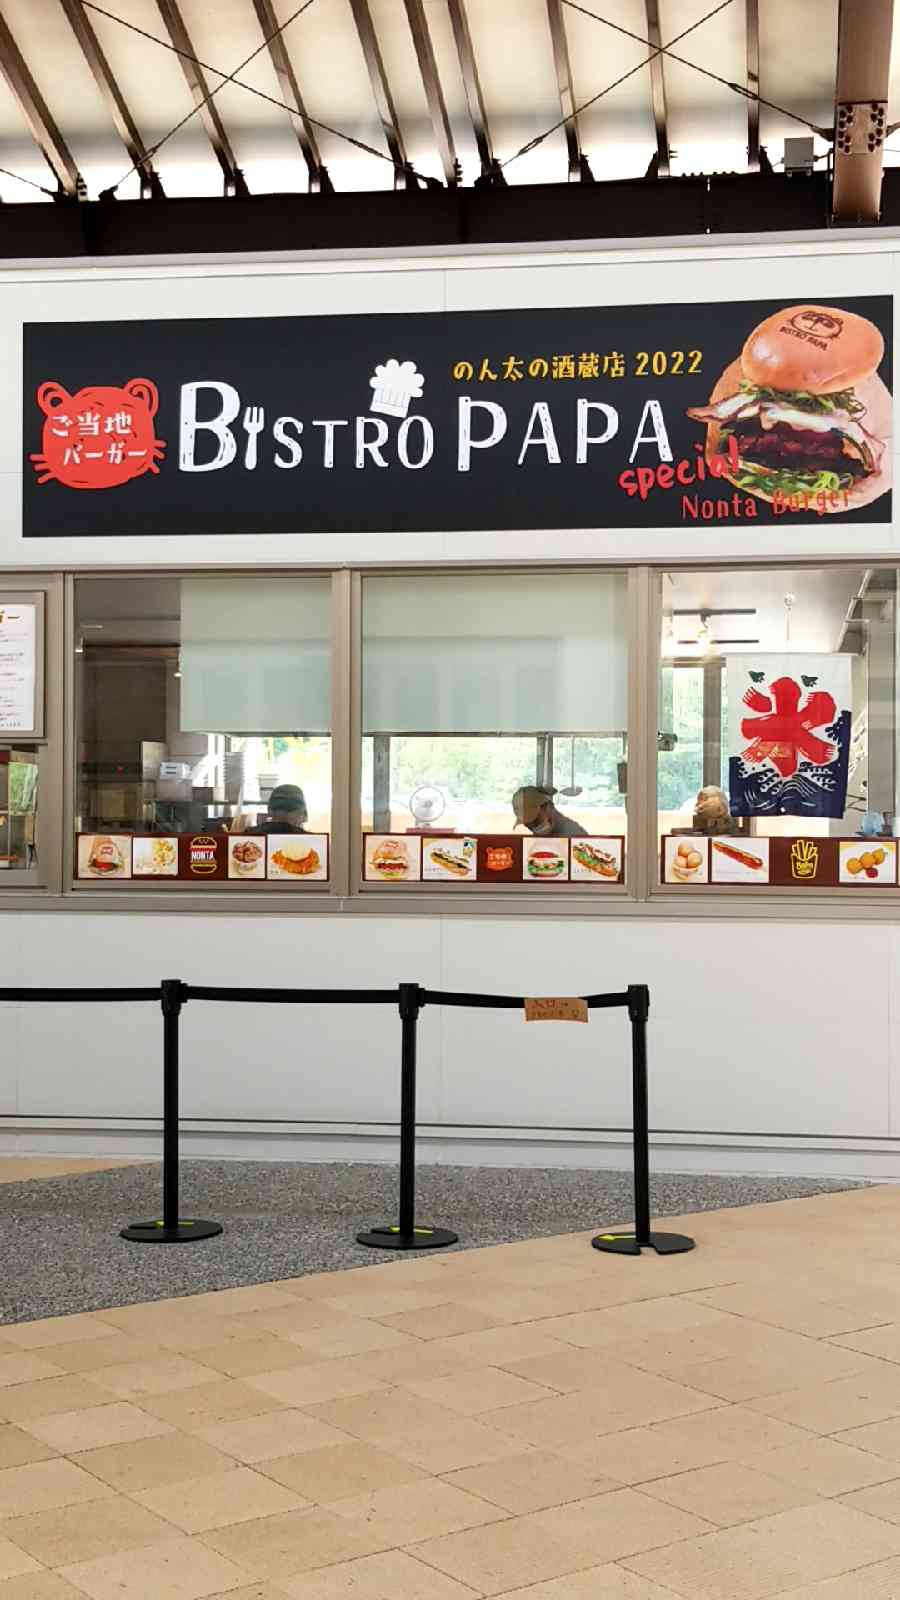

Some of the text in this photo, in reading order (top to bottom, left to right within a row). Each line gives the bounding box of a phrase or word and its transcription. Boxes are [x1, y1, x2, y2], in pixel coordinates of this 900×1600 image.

[453, 350, 703, 381] のん太の酒蔵店 2022
[51, 411, 132, 437] ご当地
[458, 396, 674, 472] PAPA
[63, 441, 148, 466] バーガー
[618, 434, 741, 501] special
[681, 488, 853, 521] Nonta Burger
